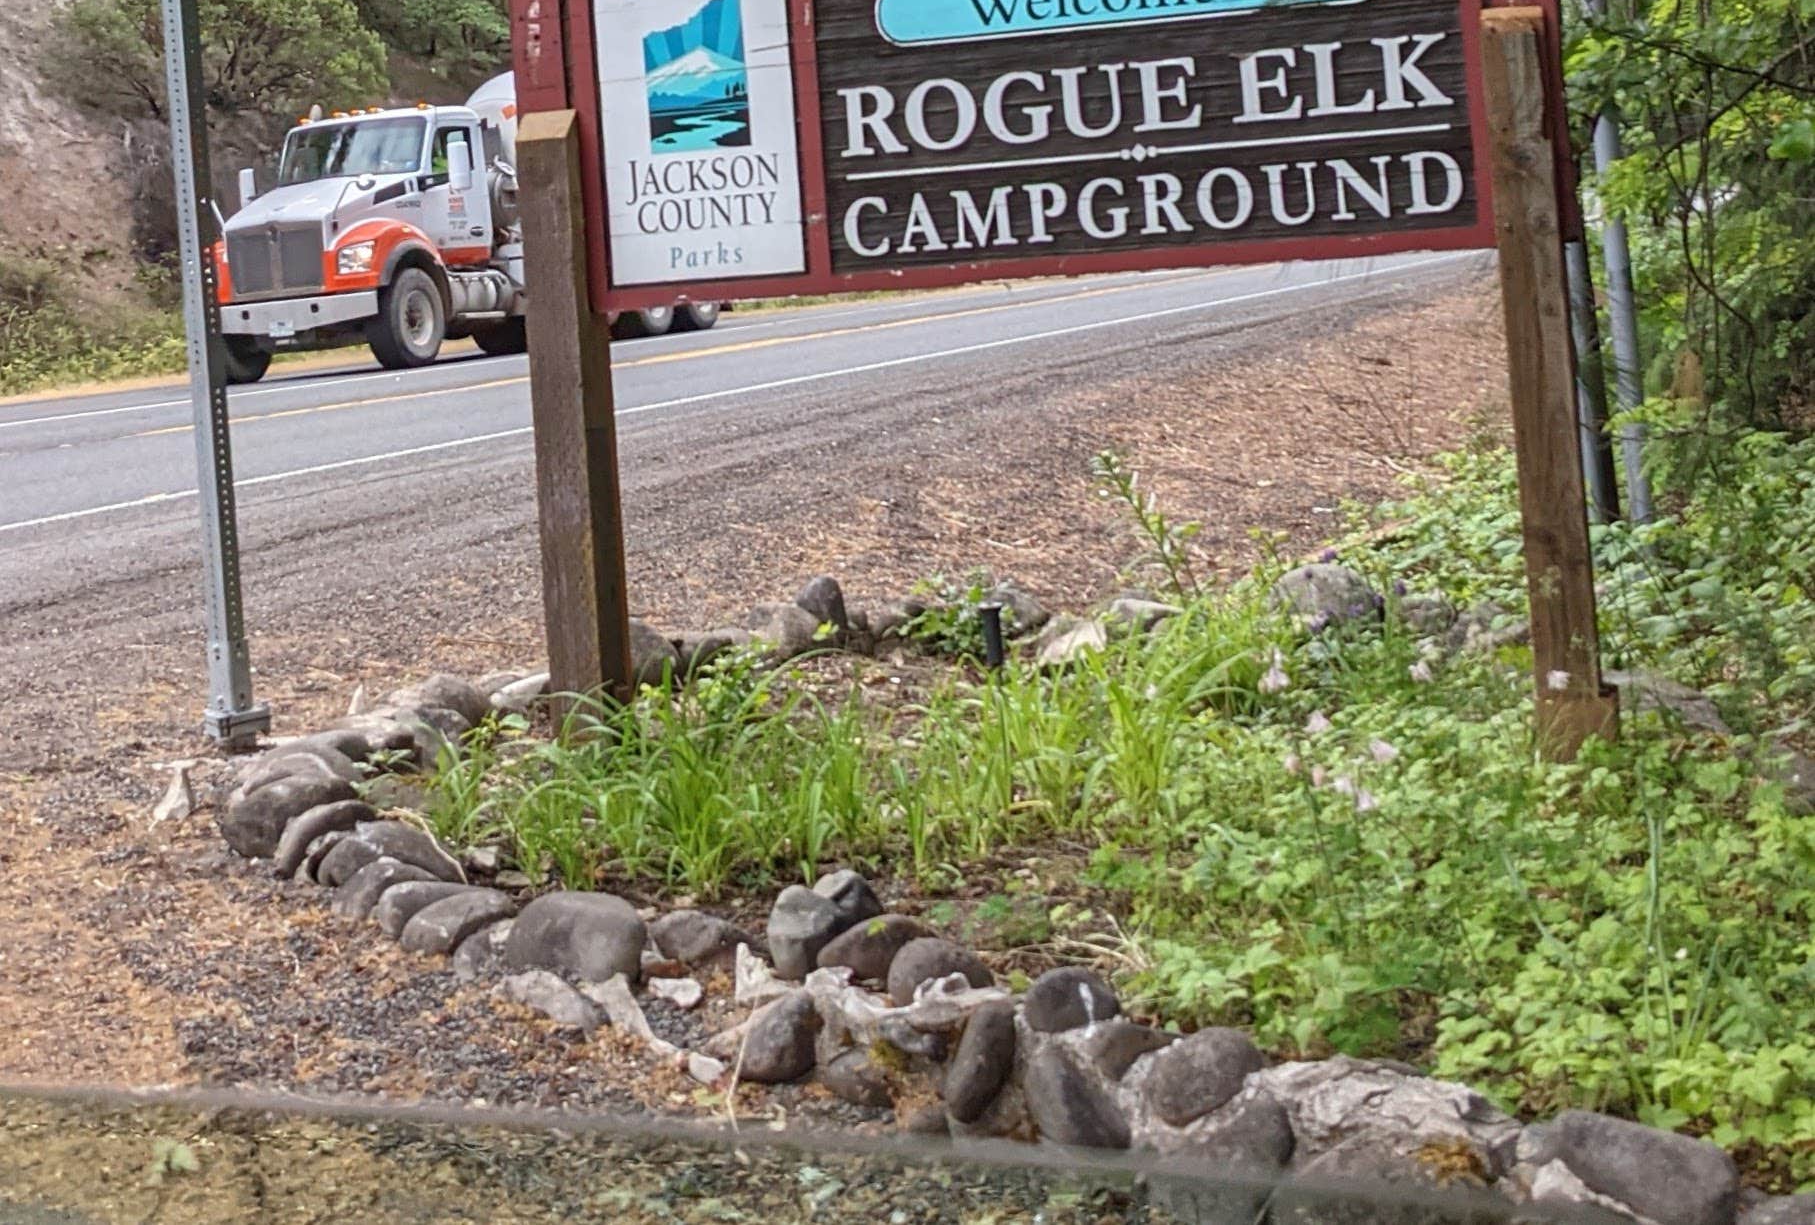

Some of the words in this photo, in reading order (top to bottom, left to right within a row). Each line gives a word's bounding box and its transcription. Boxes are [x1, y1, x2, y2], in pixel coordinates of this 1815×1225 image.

[836, 56, 1203, 158] ROGUE
[1231, 31, 1455, 124] ELK
[626, 153, 780, 206] JACKSON
[842, 150, 1464, 257] CAMPGROUND
[637, 191, 777, 234] COUNTY
[670, 241, 743, 269] Parks
